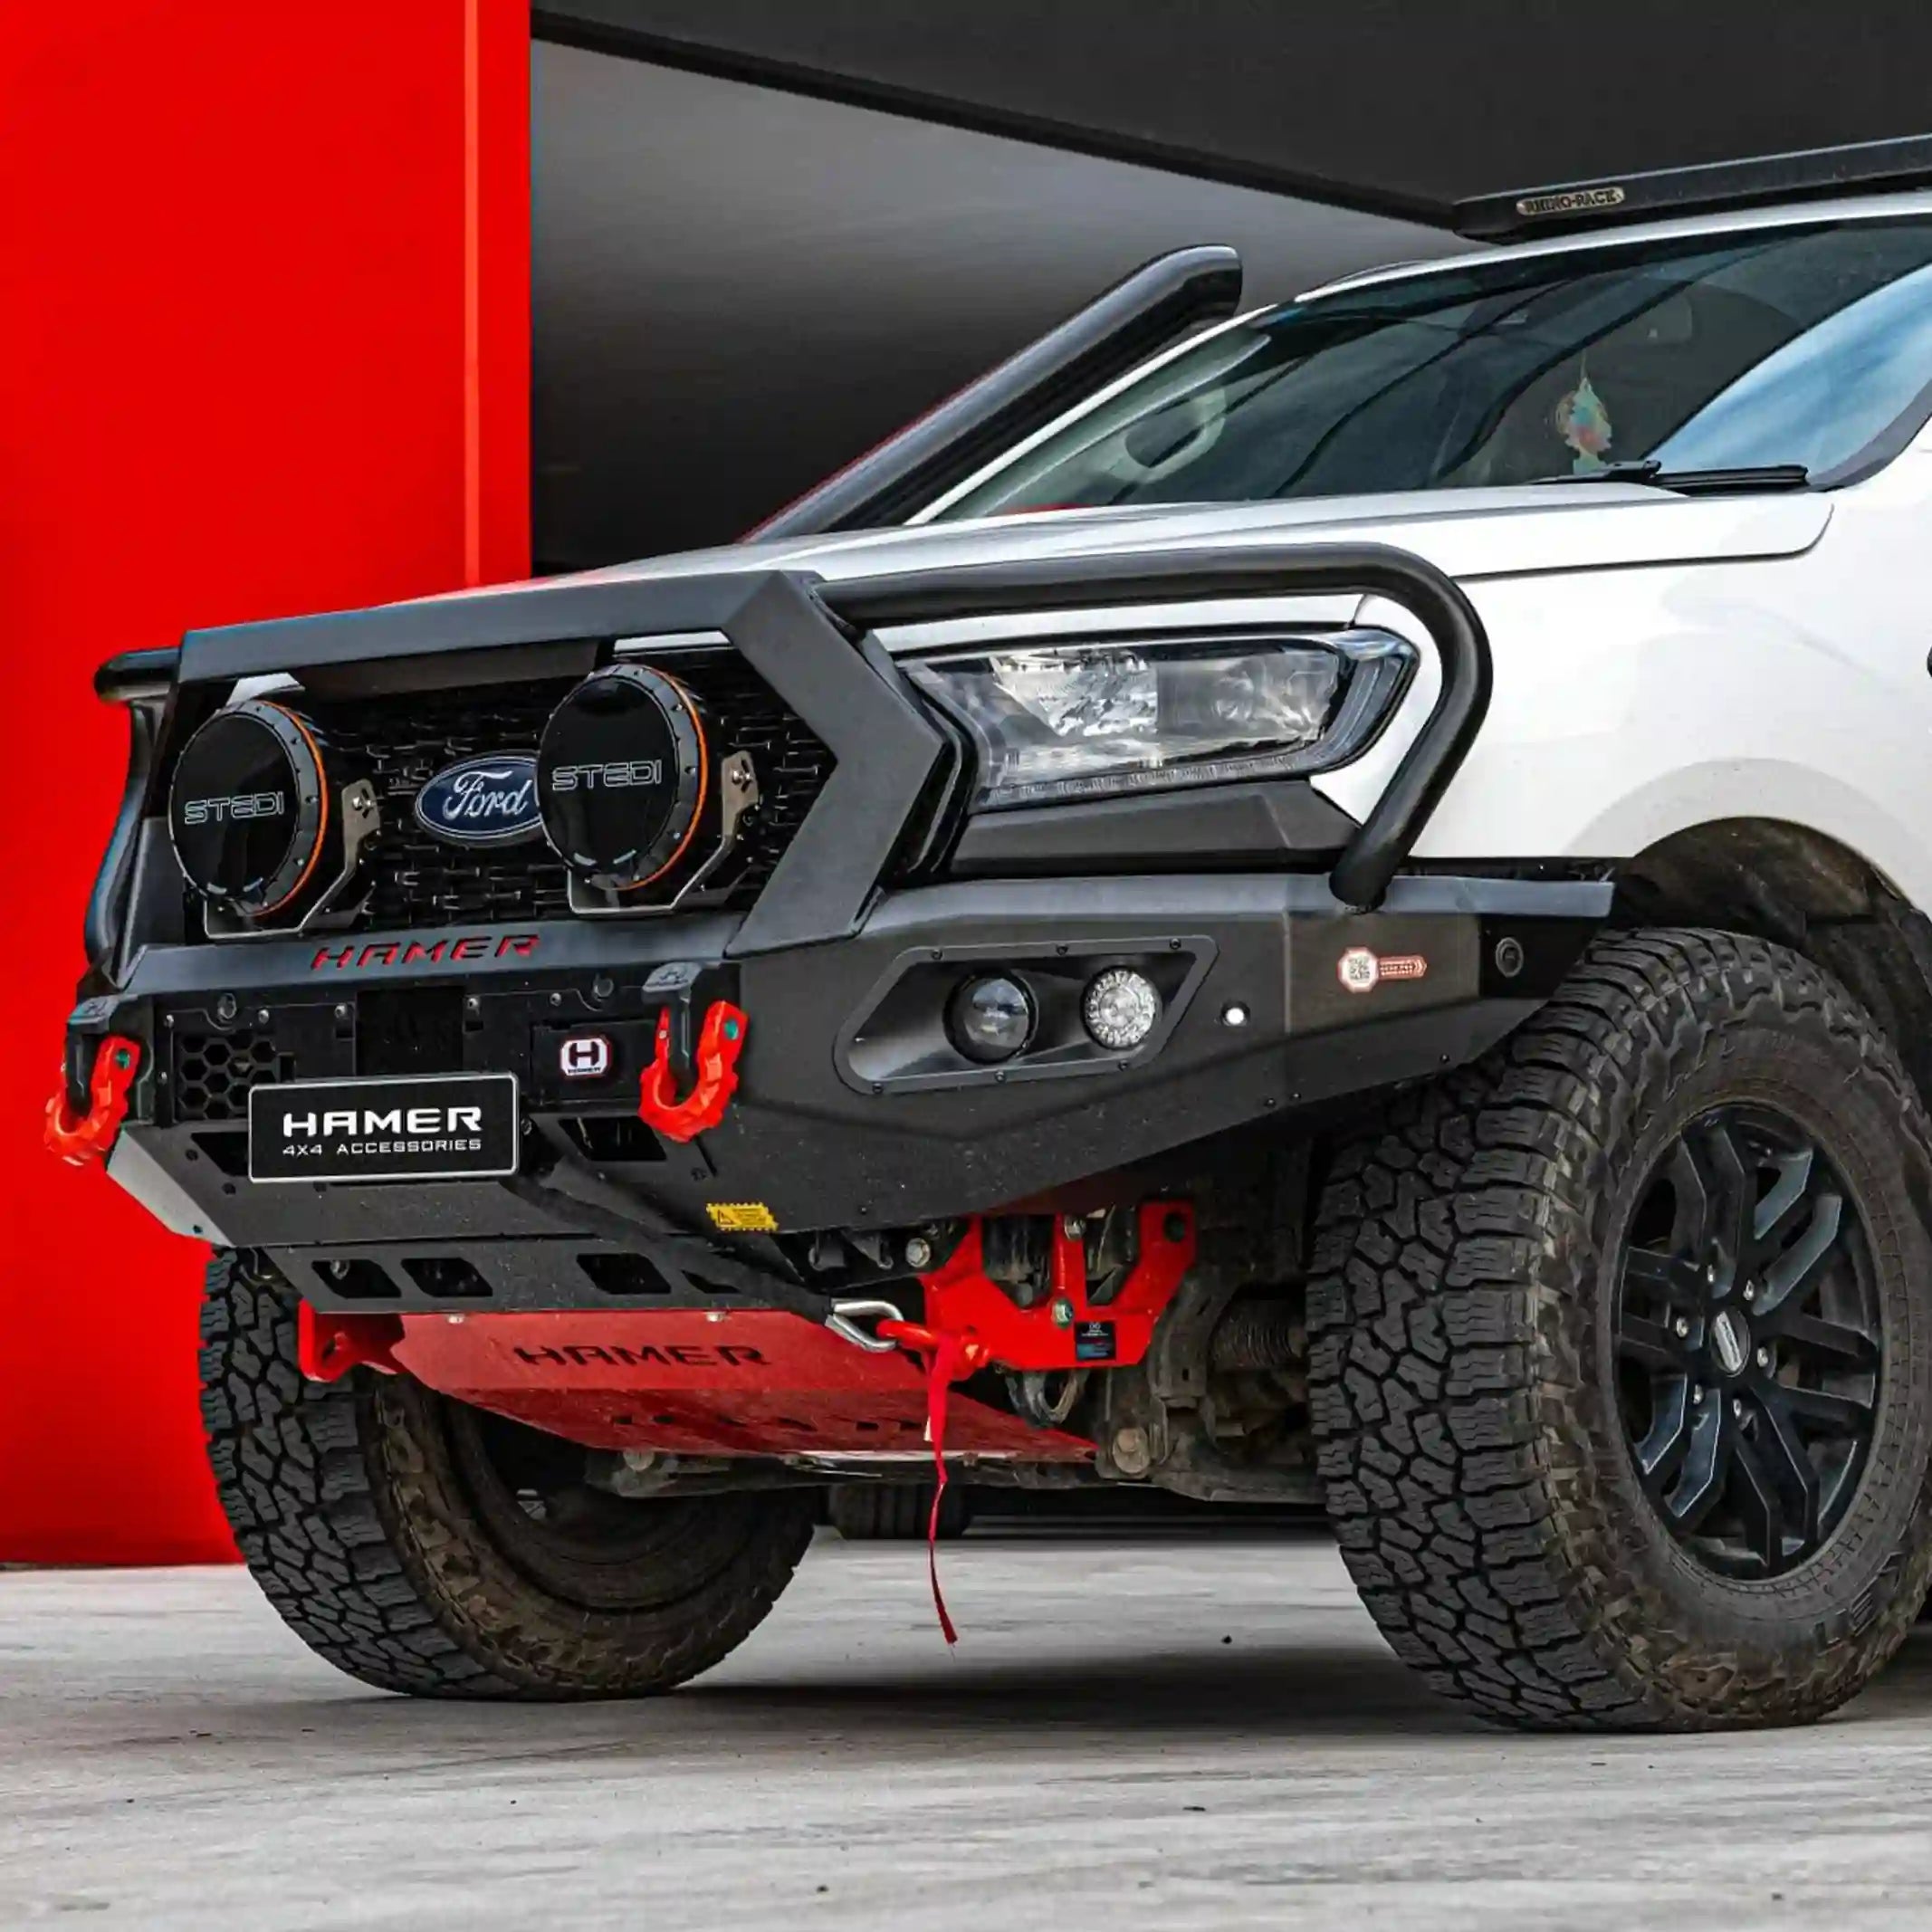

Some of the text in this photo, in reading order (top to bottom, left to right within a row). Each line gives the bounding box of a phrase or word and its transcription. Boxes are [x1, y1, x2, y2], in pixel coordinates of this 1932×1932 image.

[551, 760, 662, 791] STEDI
[185, 791, 284, 825] STEDI
[443, 770, 533, 819] Ford
[311, 933, 540, 971] HAMER
[282, 1106, 482, 1137] HAMER
[336, 1138, 482, 1155] ACCESSORIES
[512, 1345, 772, 1366] HAMER
